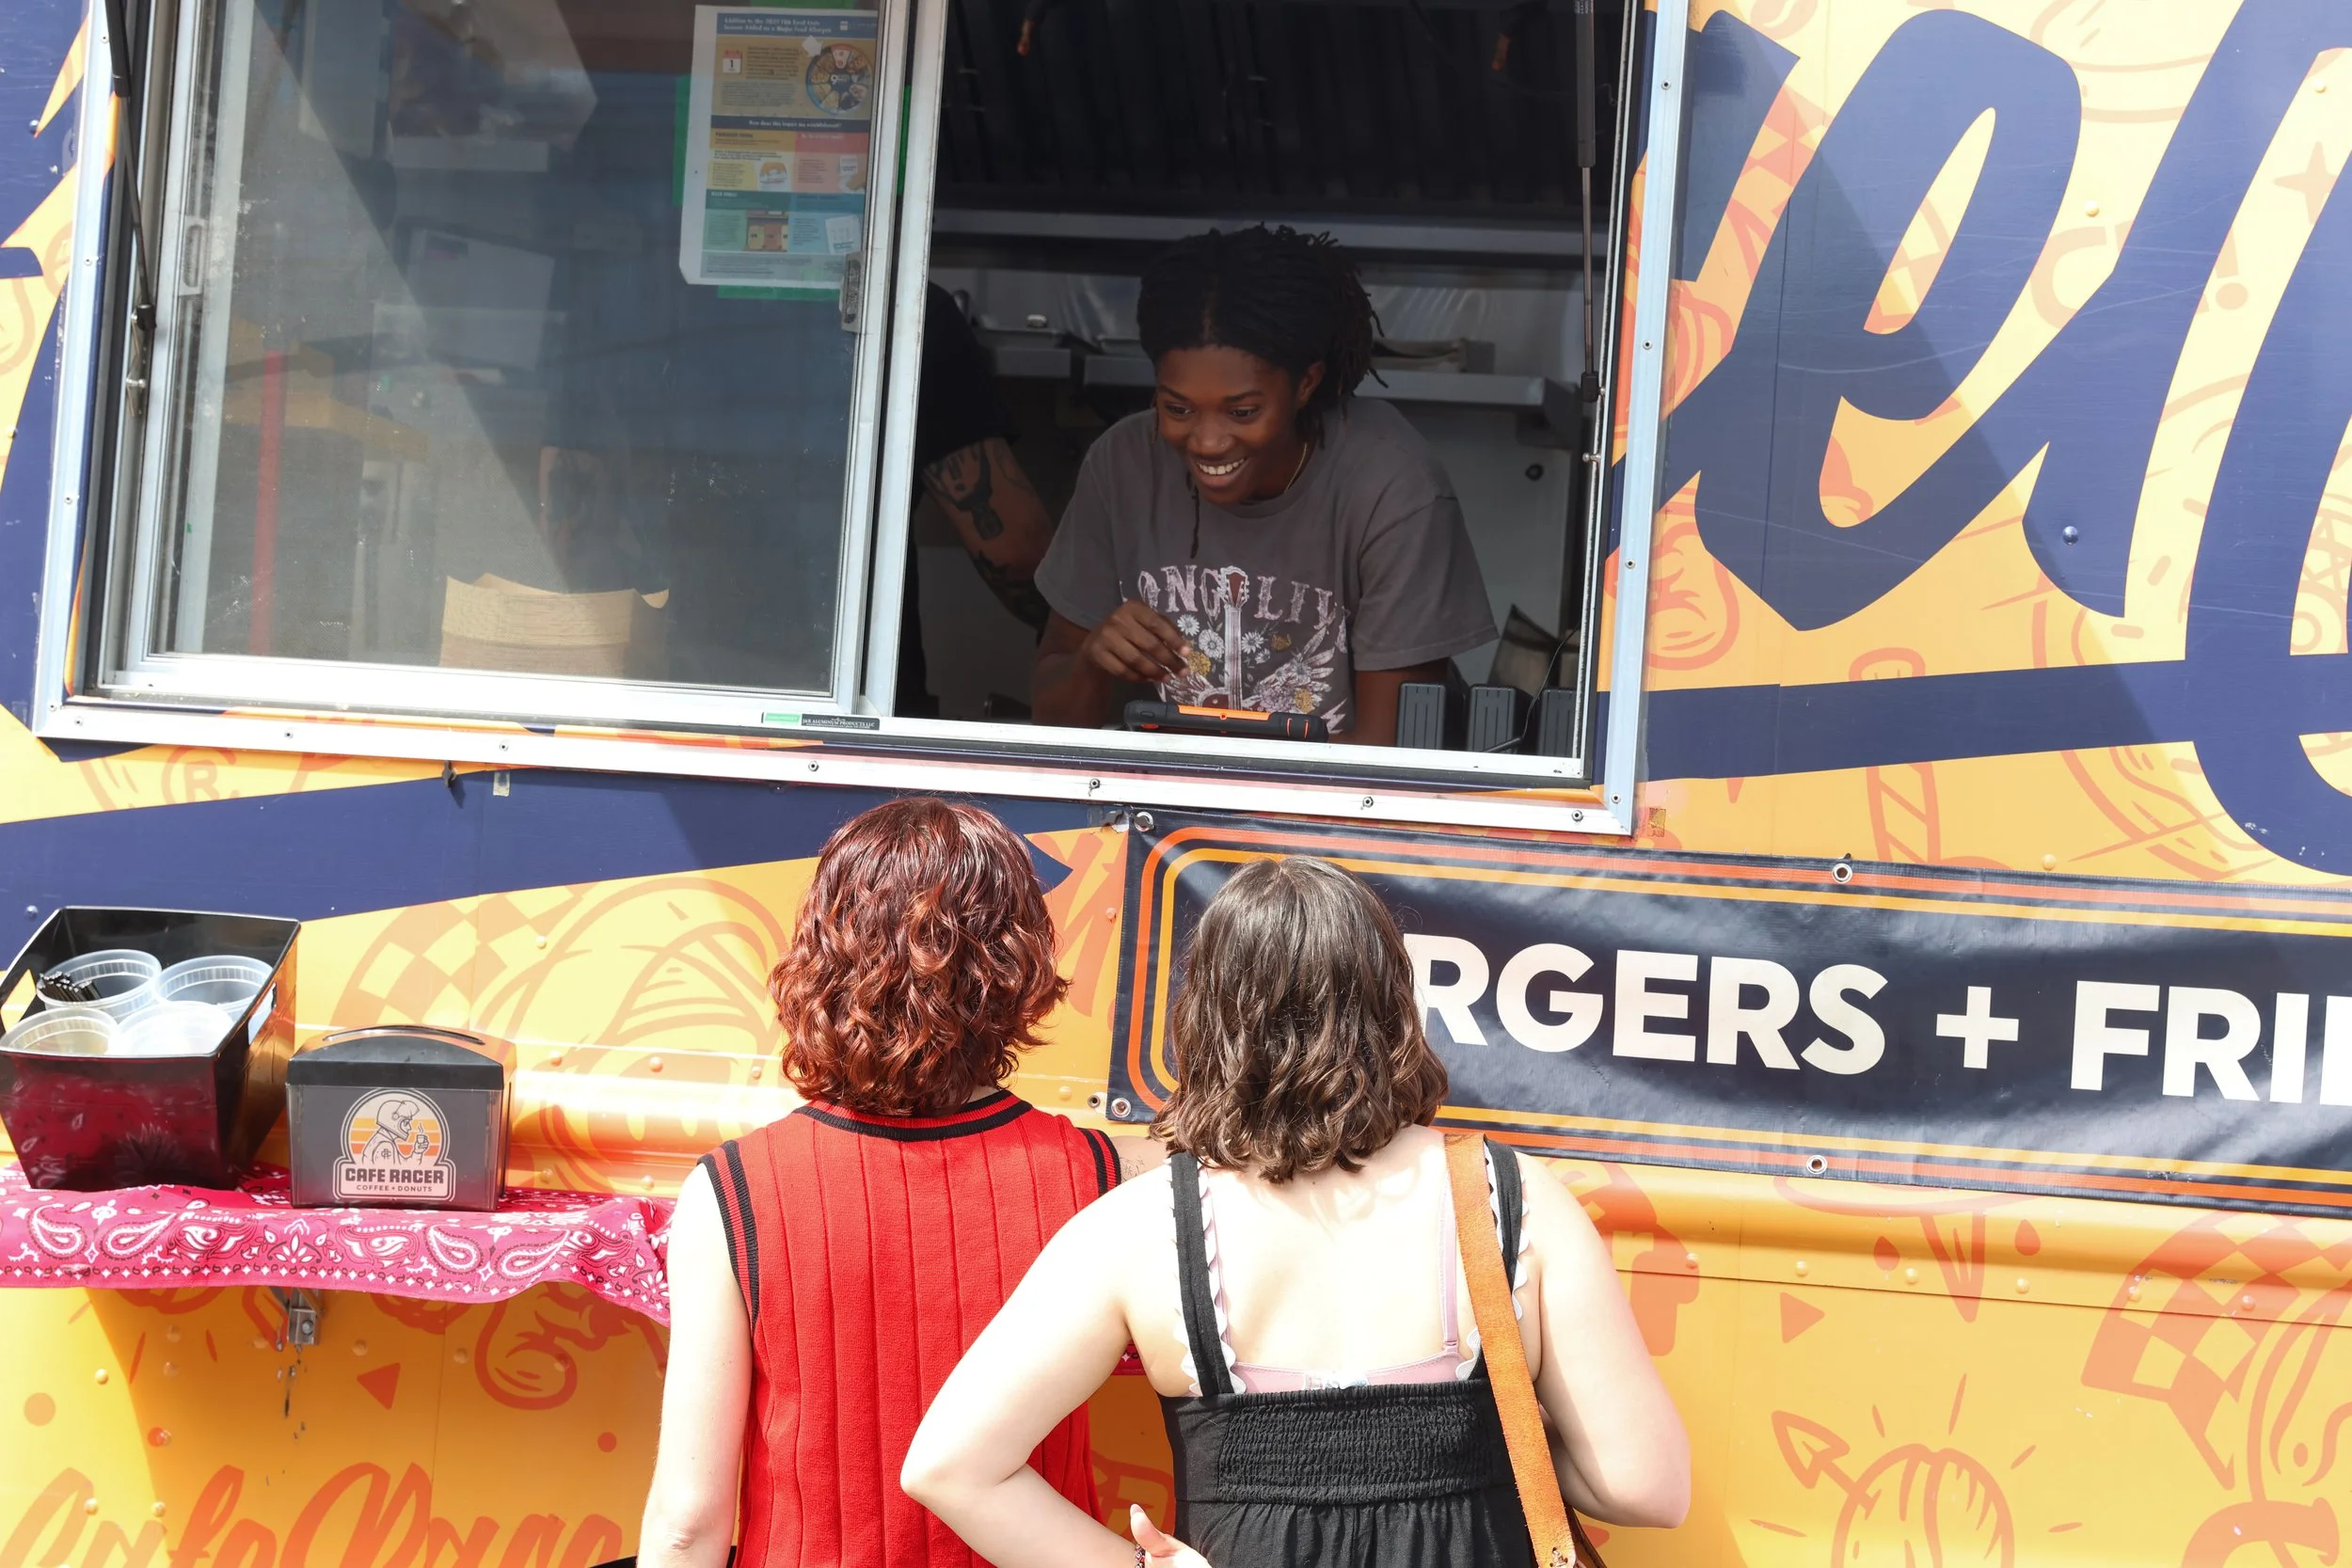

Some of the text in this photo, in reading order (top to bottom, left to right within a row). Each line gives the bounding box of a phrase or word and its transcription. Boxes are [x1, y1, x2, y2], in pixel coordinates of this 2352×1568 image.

[1119, 564, 1225, 626] ONG
[1403, 933, 1888, 1075] RGERS
[345, 1167, 444, 1184] CAFE RACER
